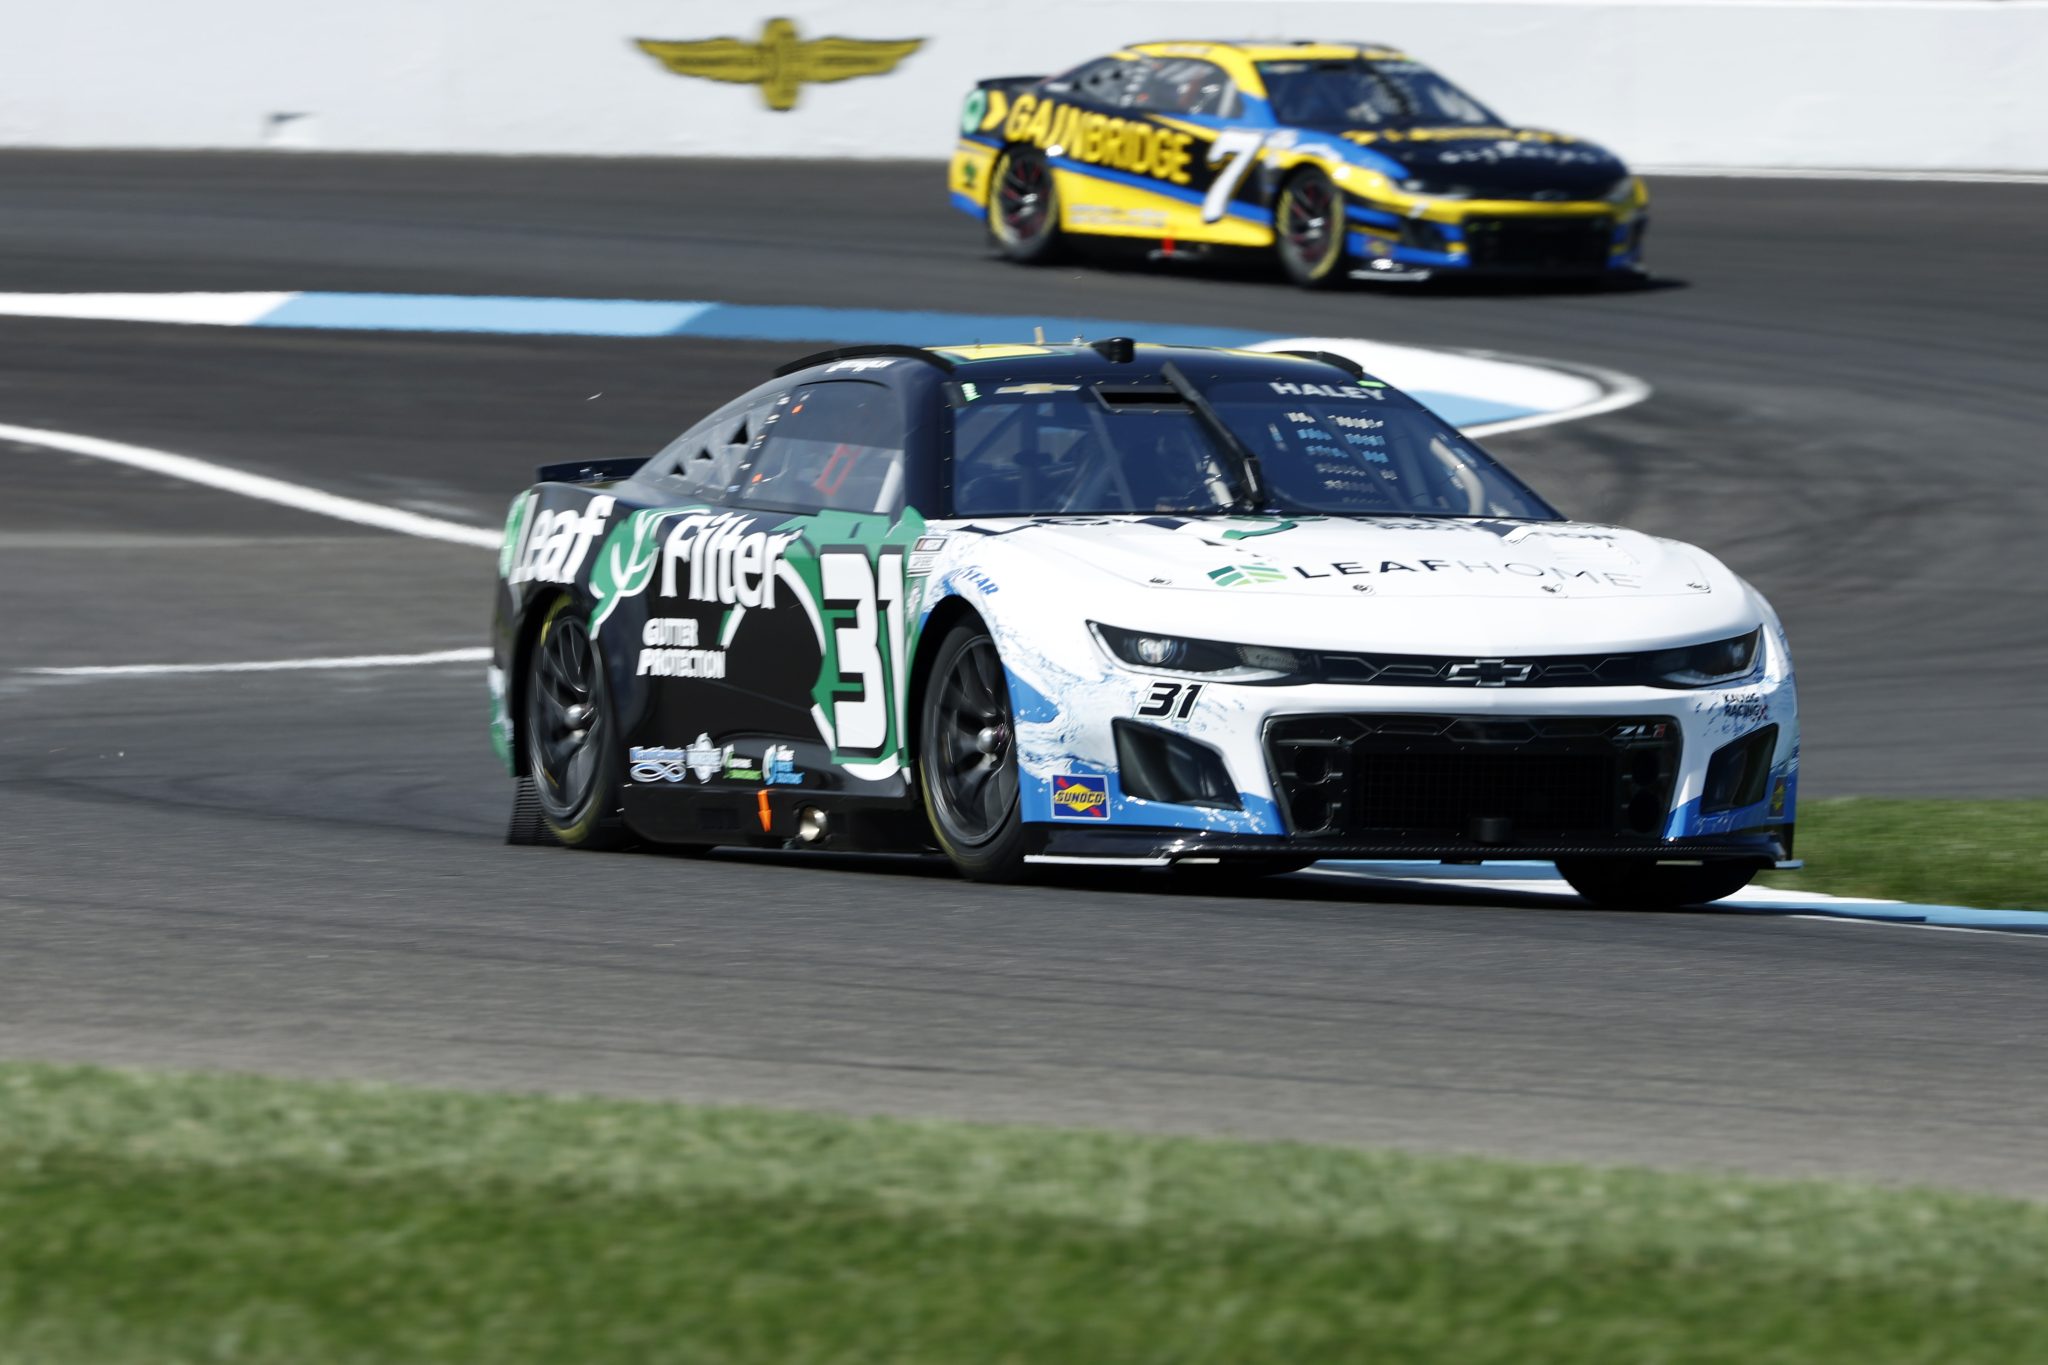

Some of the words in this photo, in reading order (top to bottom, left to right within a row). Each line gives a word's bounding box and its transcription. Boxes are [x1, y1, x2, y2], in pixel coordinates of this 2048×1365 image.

[1005, 94, 1191, 183] GAINBRIDGE
[1203, 128, 1263, 223] 7
[1269, 382, 1385, 400] HALEY
[660, 512, 803, 609] Filter
[642, 618, 699, 647] GUTTER
[636, 648, 726, 679] PROTECTION
[820, 550, 905, 754] 31
[1138, 682, 1203, 719] 31
[1613, 724, 1666, 739] ZL1
[1055, 790, 1106, 805] SUNOCO
